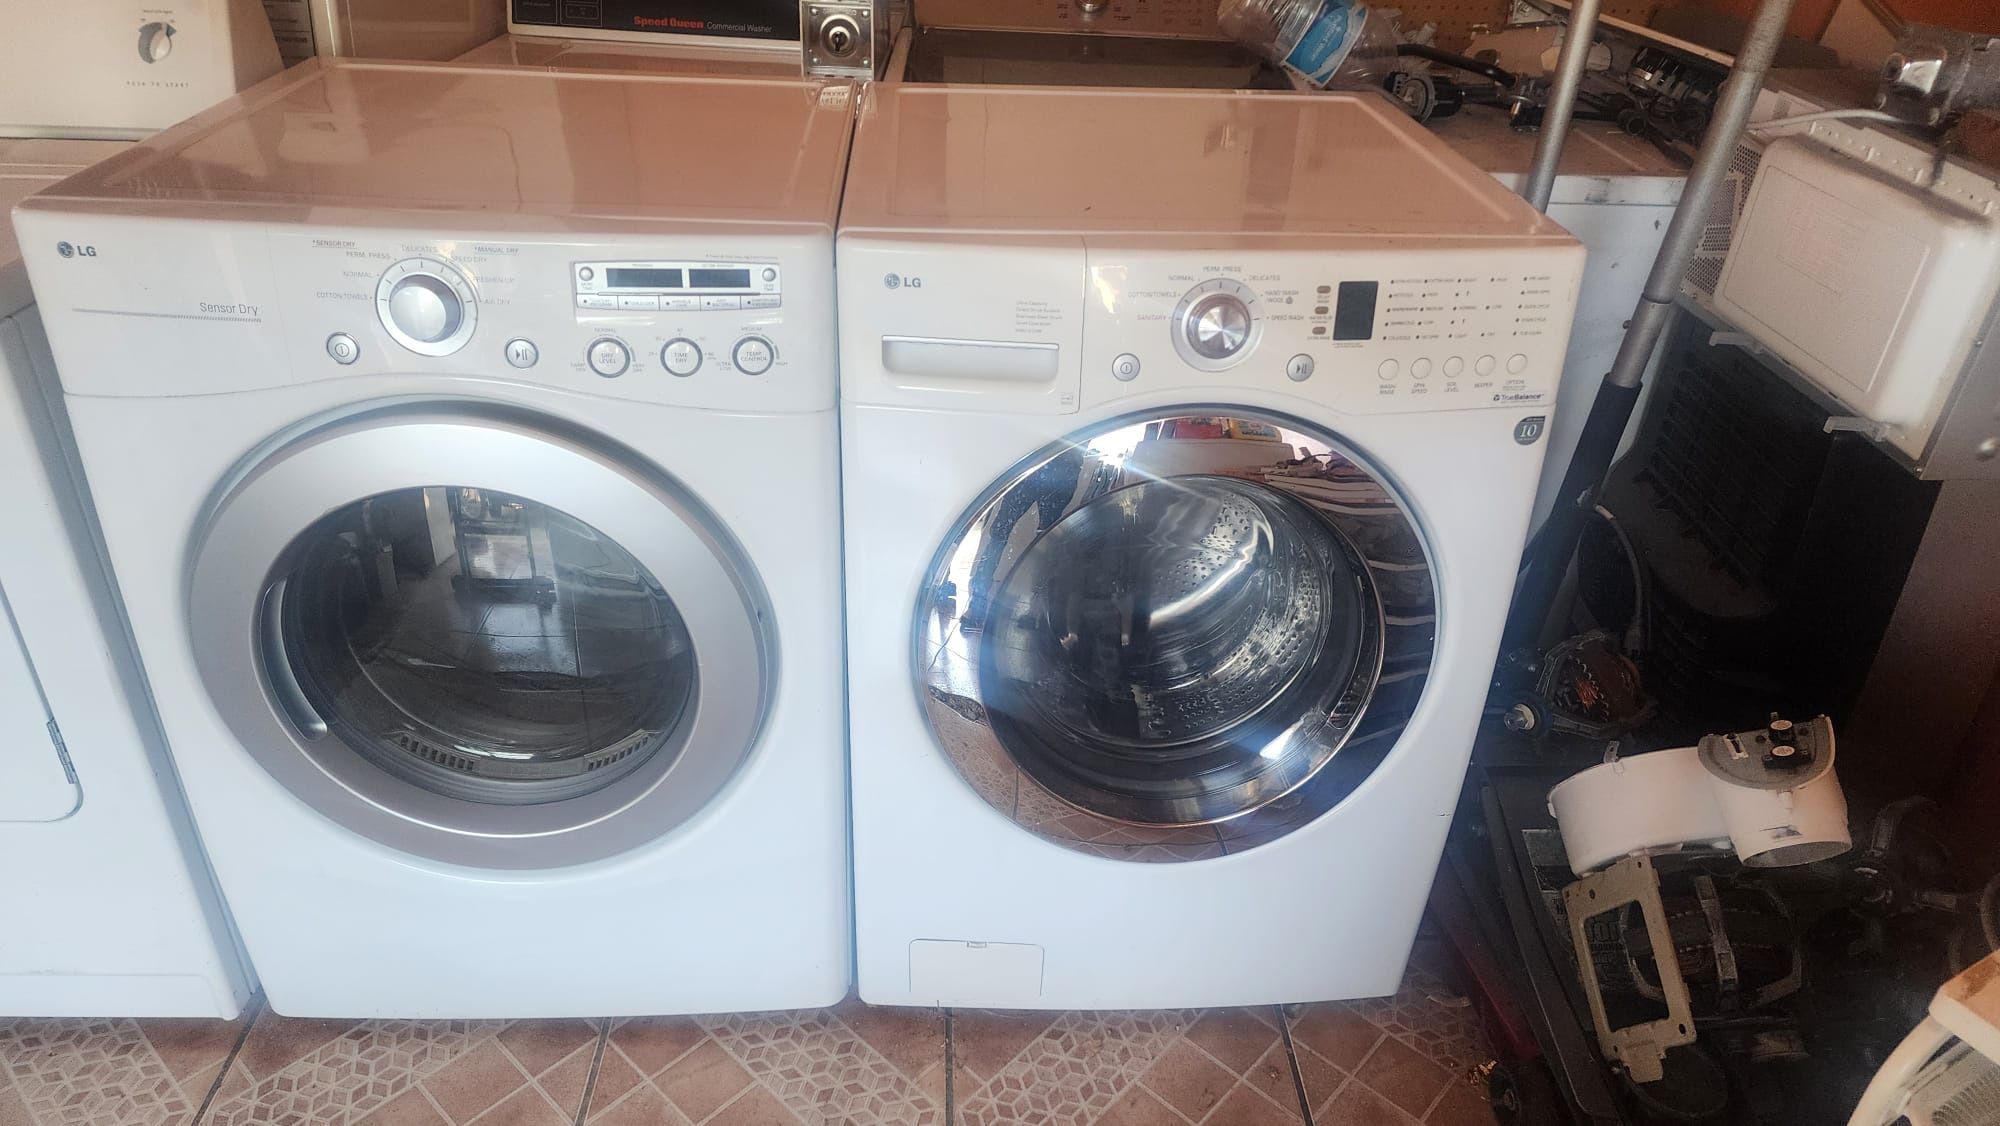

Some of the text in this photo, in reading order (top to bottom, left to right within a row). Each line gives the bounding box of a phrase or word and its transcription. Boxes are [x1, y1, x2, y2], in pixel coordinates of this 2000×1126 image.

[634, 16, 772, 33] Speed Queen Commercial Washer
[77, 245, 97, 257] LG
[904, 277, 921, 288] LG
[200, 302, 258, 317] Sensor Dry
[1519, 424, 1537, 438] 10
